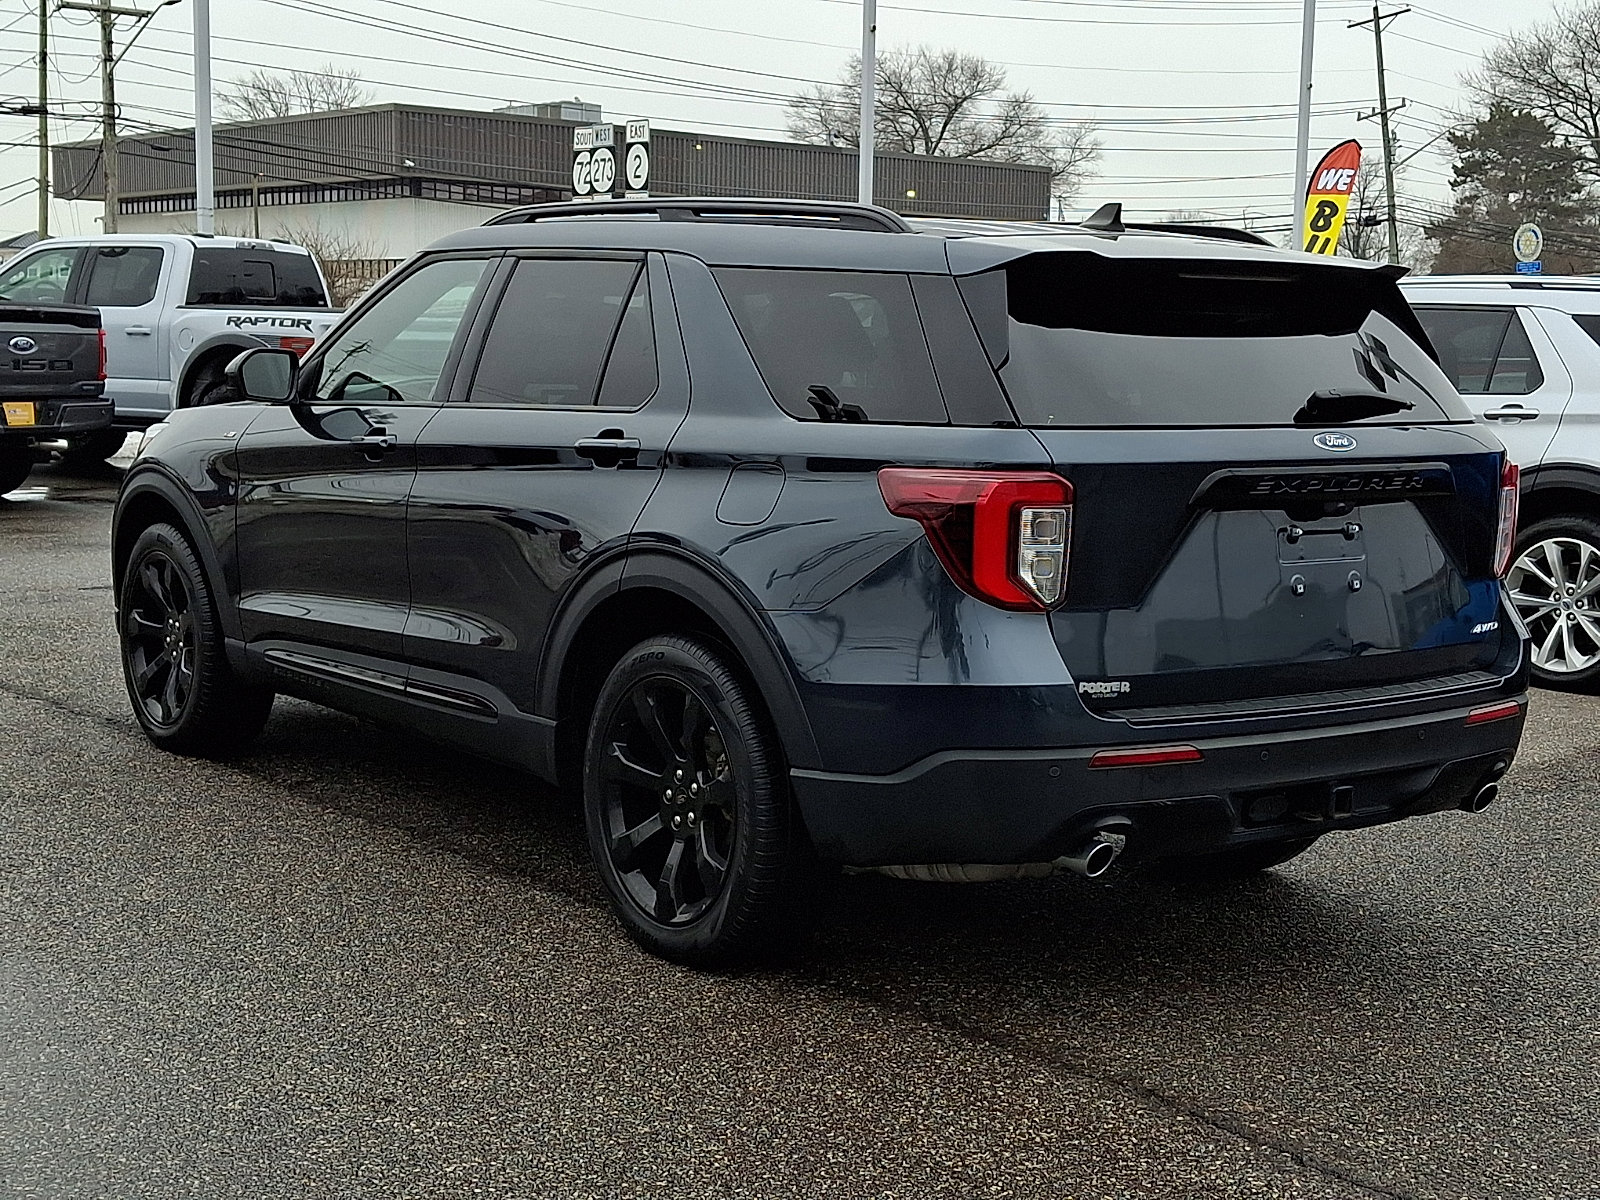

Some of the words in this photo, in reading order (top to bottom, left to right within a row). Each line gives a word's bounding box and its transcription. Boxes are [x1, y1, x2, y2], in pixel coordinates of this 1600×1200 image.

[575, 132, 592, 146] SOUT
[594, 128, 611, 143] WEST
[630, 125, 646, 139] EAST
[593, 157, 614, 183] 273
[633, 154, 642, 179] 2
[1316, 168, 1355, 191] WE
[1305, 200, 1339, 255] BU
[225, 316, 314, 333] RAPTOR
[1325, 434, 1350, 446] Ford
[1250, 475, 1424, 494] EXPLORER
[1079, 681, 1131, 693] PORTER
